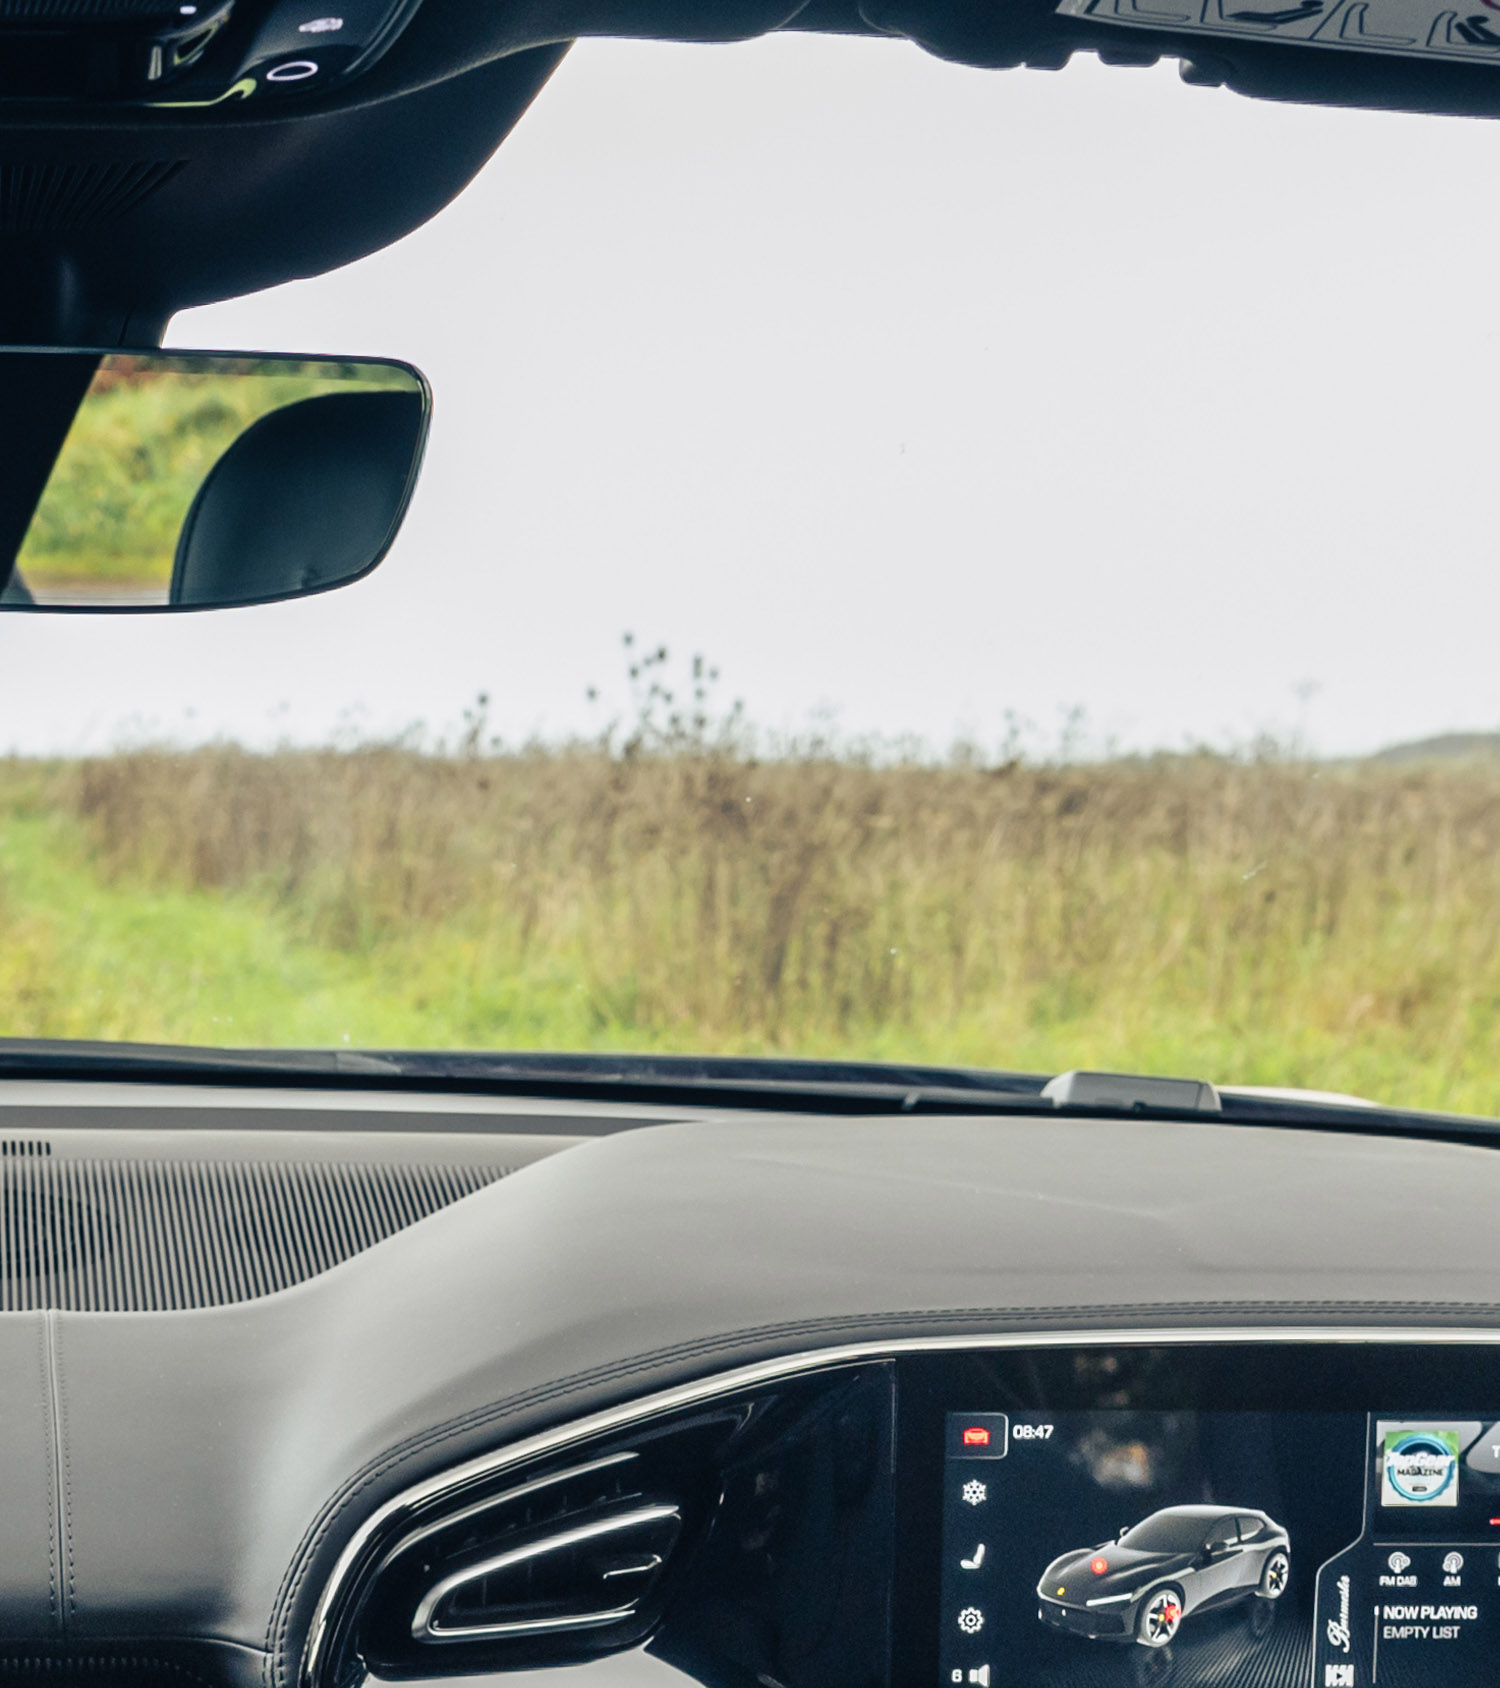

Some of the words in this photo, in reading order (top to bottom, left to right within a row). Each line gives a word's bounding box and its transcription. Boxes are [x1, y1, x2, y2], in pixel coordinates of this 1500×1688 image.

[1013, 1425, 1054, 1440] 08:47
[1379, 1575, 1396, 1587] FM
[1397, 1575, 1417, 1587] DAB
[1443, 1575, 1461, 1587] AM
[1383, 1605, 1418, 1620] NOW
[1420, 1605, 1478, 1620] PLAYING
[1383, 1626, 1430, 1640] EMPTY
[1432, 1626, 1461, 1640] LIST
[951, 1669, 962, 1684] 6
